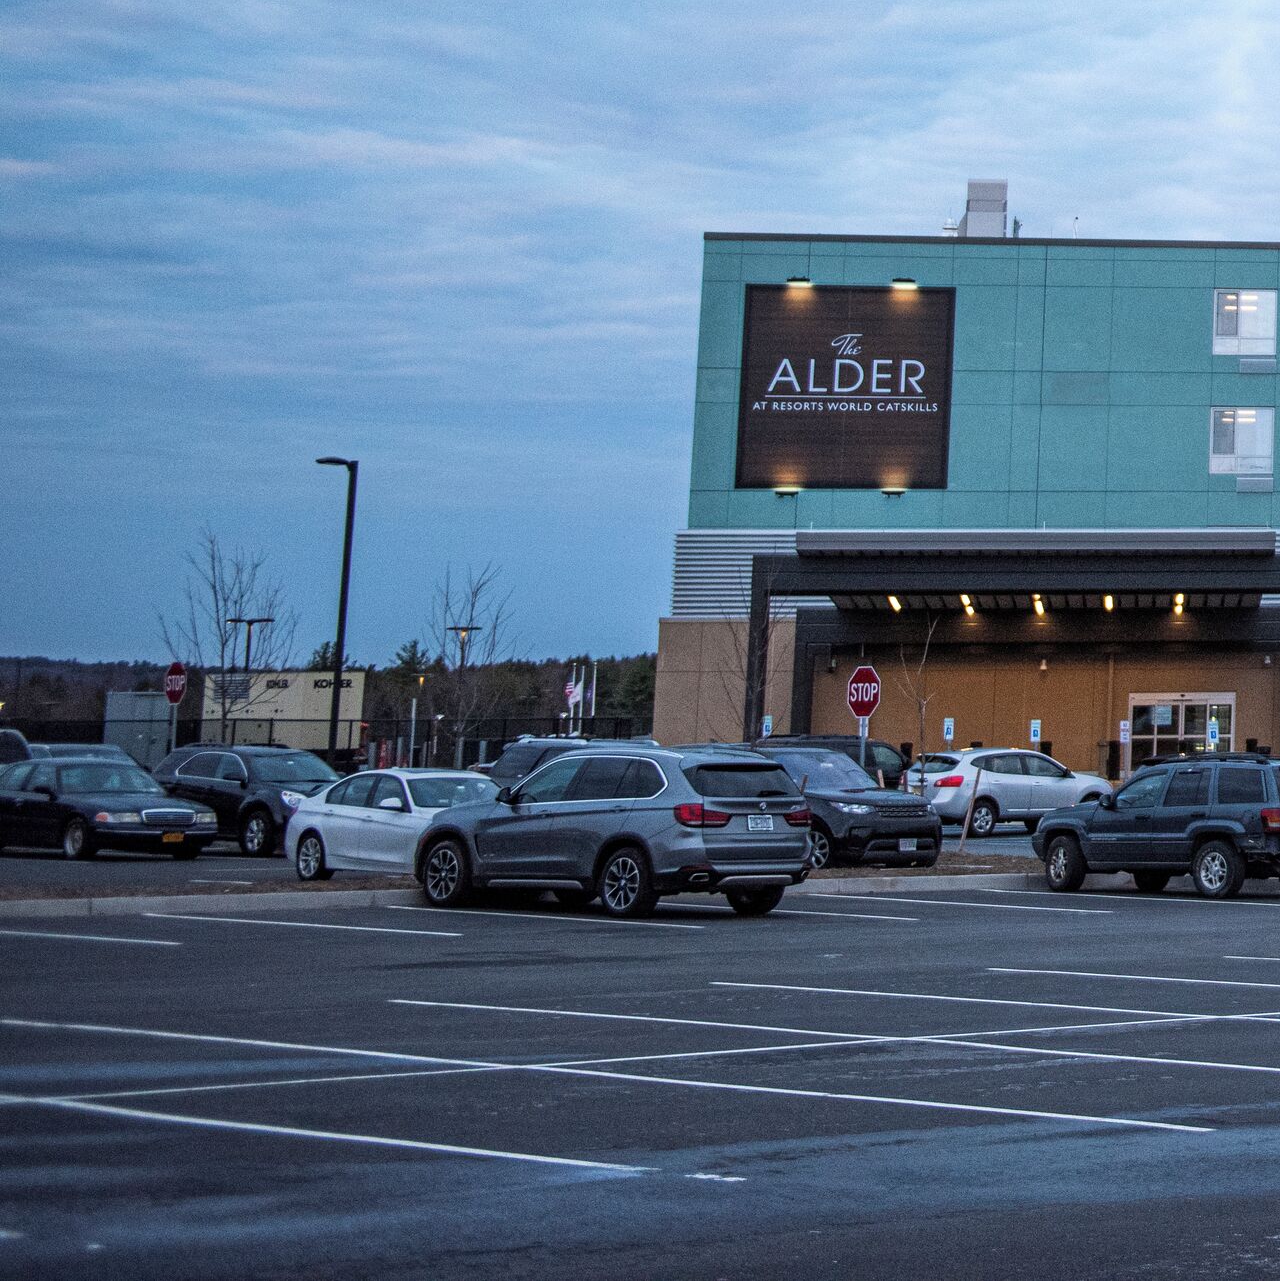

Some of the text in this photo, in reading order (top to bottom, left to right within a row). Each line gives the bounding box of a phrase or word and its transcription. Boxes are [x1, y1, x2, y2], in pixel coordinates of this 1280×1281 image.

[831, 333, 863, 355] The
[768, 358, 925, 393] ALDER
[753, 401, 938, 412] AT RESORTS WORLD CATSKILLS
[167, 675, 185, 690] STOP
[314, 679, 353, 688] KOHER
[850, 683, 878, 702] STOP
